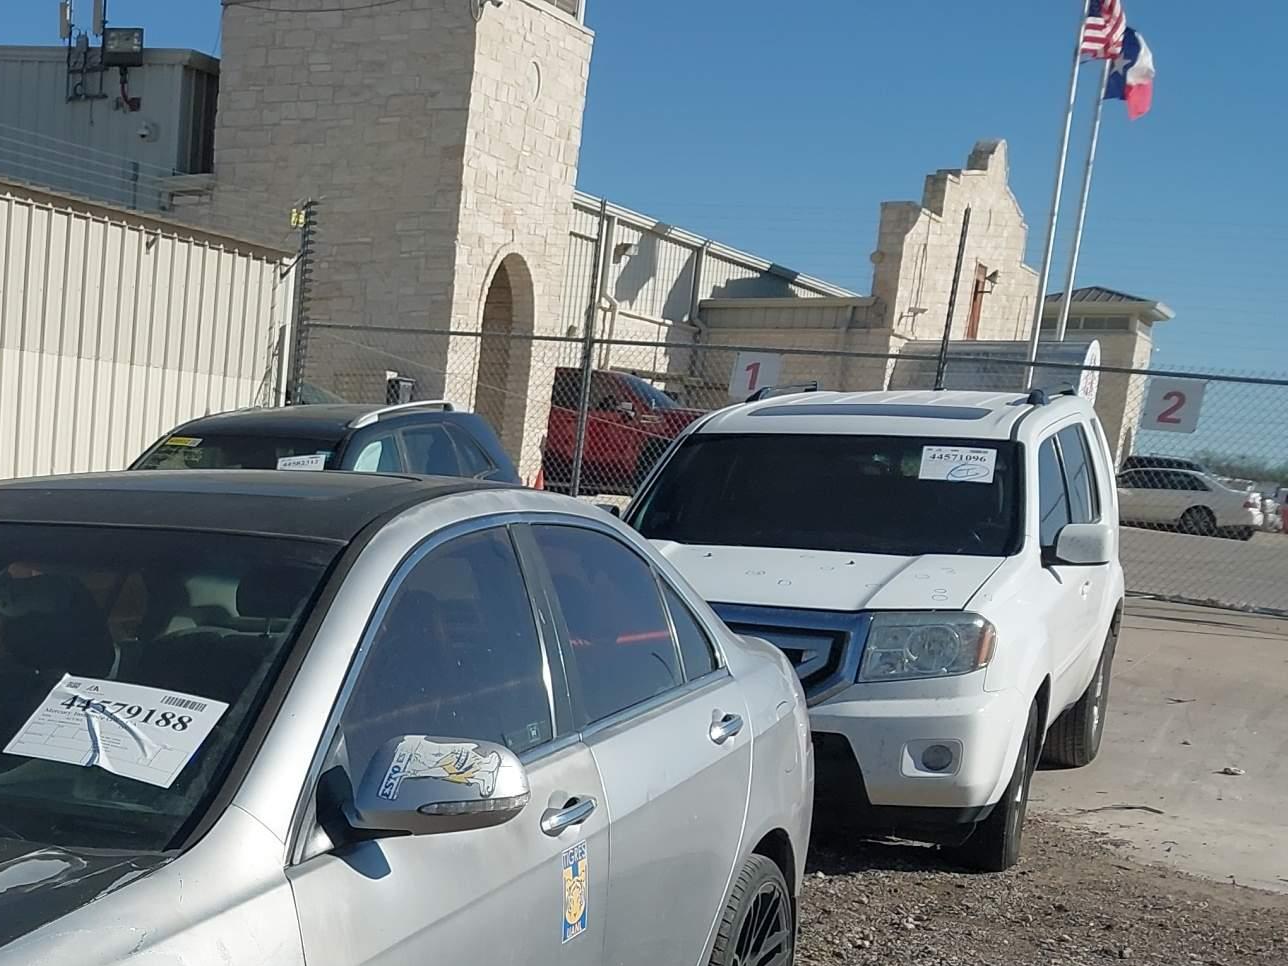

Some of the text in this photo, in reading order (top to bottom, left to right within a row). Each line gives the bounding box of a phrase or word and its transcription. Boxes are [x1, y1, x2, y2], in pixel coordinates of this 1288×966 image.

[745, 362, 761, 390] 1
[1157, 391, 1186, 424] 2
[929, 453, 987, 463] 44571096
[60, 694, 193, 733] 44579188
[381, 765, 401, 798] ESTO
[561, 842, 587, 867] TIGRES
